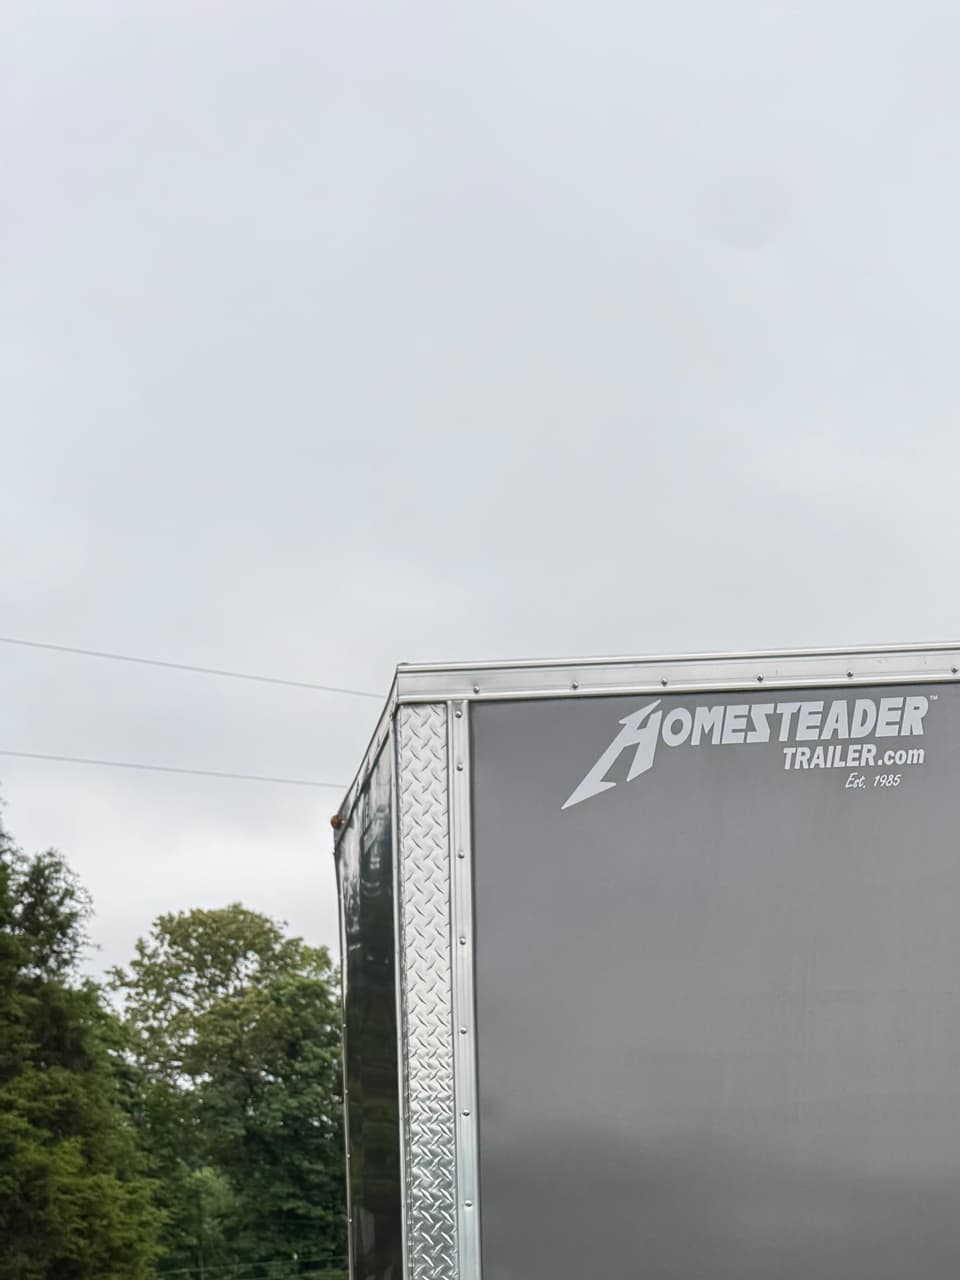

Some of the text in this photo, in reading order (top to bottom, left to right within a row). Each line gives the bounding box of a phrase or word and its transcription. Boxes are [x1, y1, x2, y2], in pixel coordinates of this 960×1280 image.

[560, 695, 929, 810] HOMESTEADER
[783, 743, 925, 770] TRAILER.com
[845, 772, 902, 789] Est. 1985
